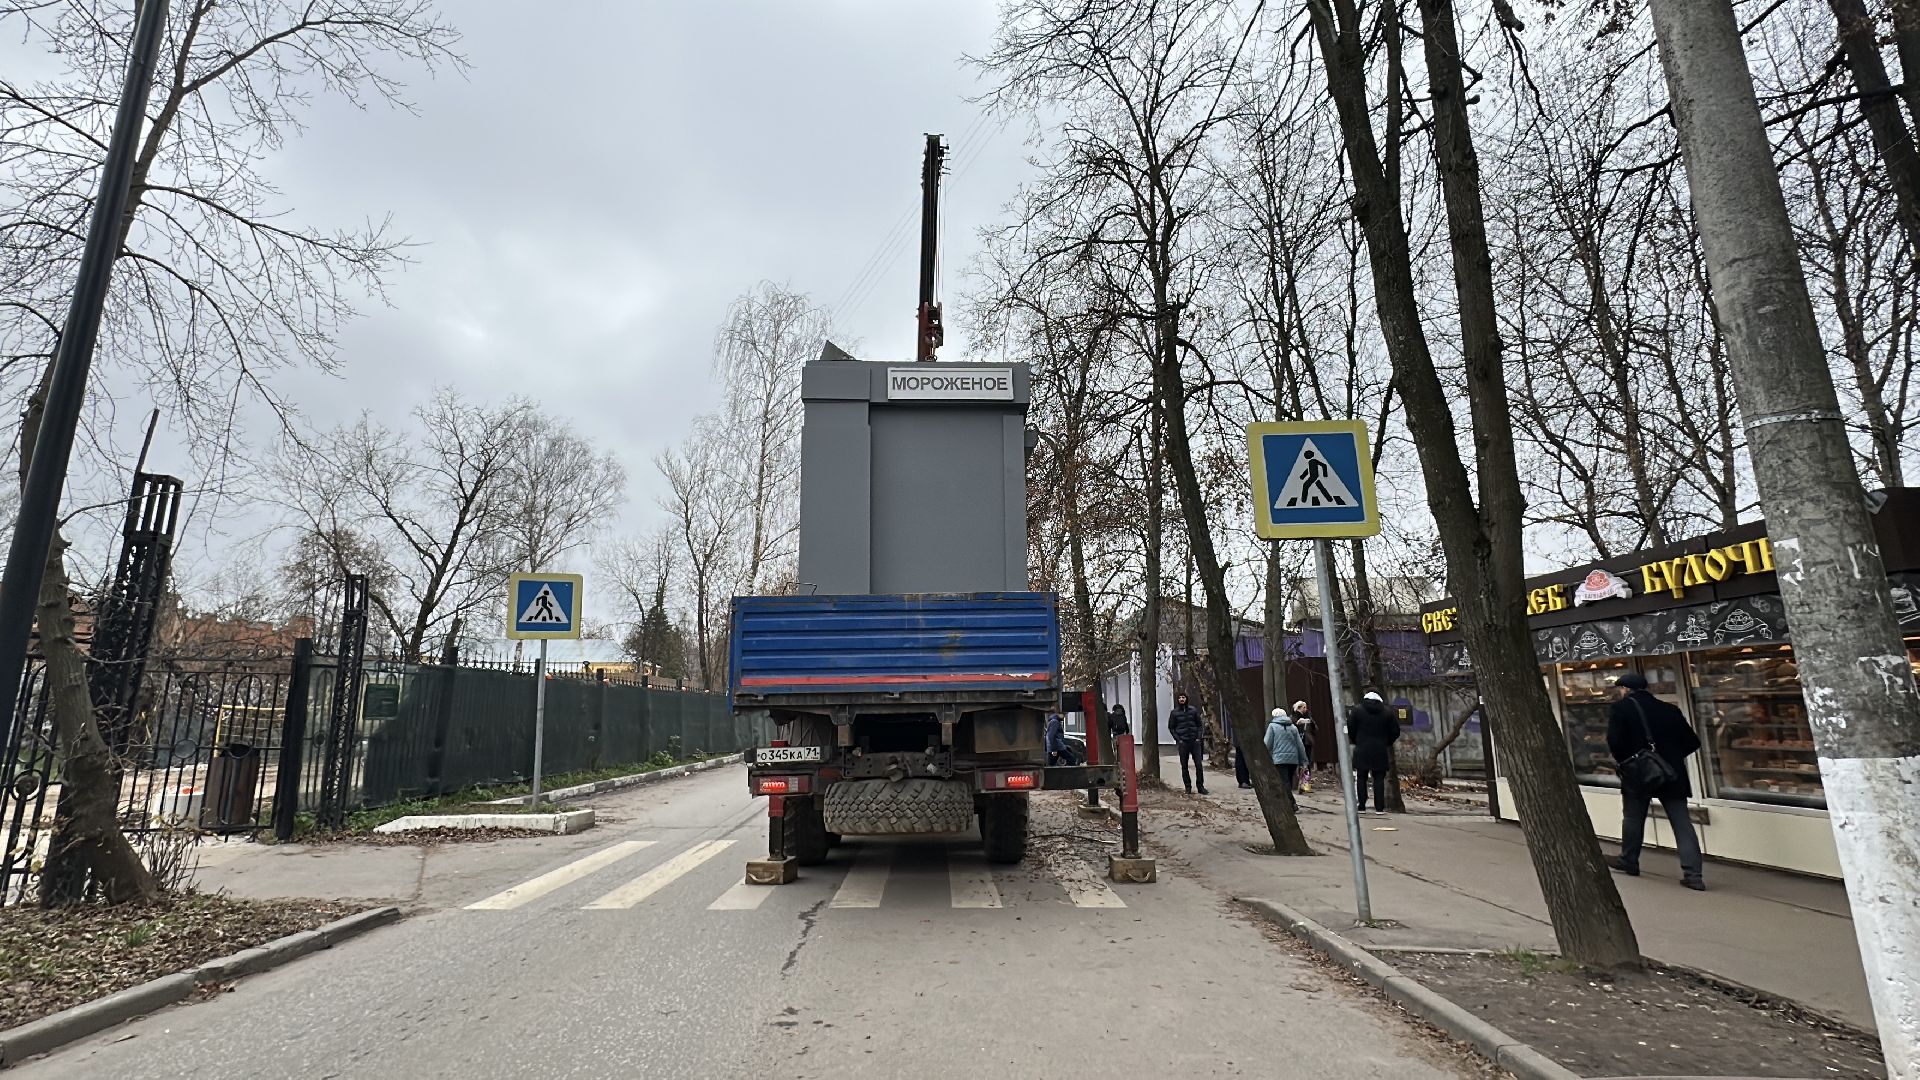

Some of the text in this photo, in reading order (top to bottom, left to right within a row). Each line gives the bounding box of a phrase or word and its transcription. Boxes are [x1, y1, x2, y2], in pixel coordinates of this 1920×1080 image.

[892, 377, 1008, 390] МОРОЖЕНОЕ
[1422, 607, 1458, 634] СВЕ
[805, 747, 817, 757] 71
